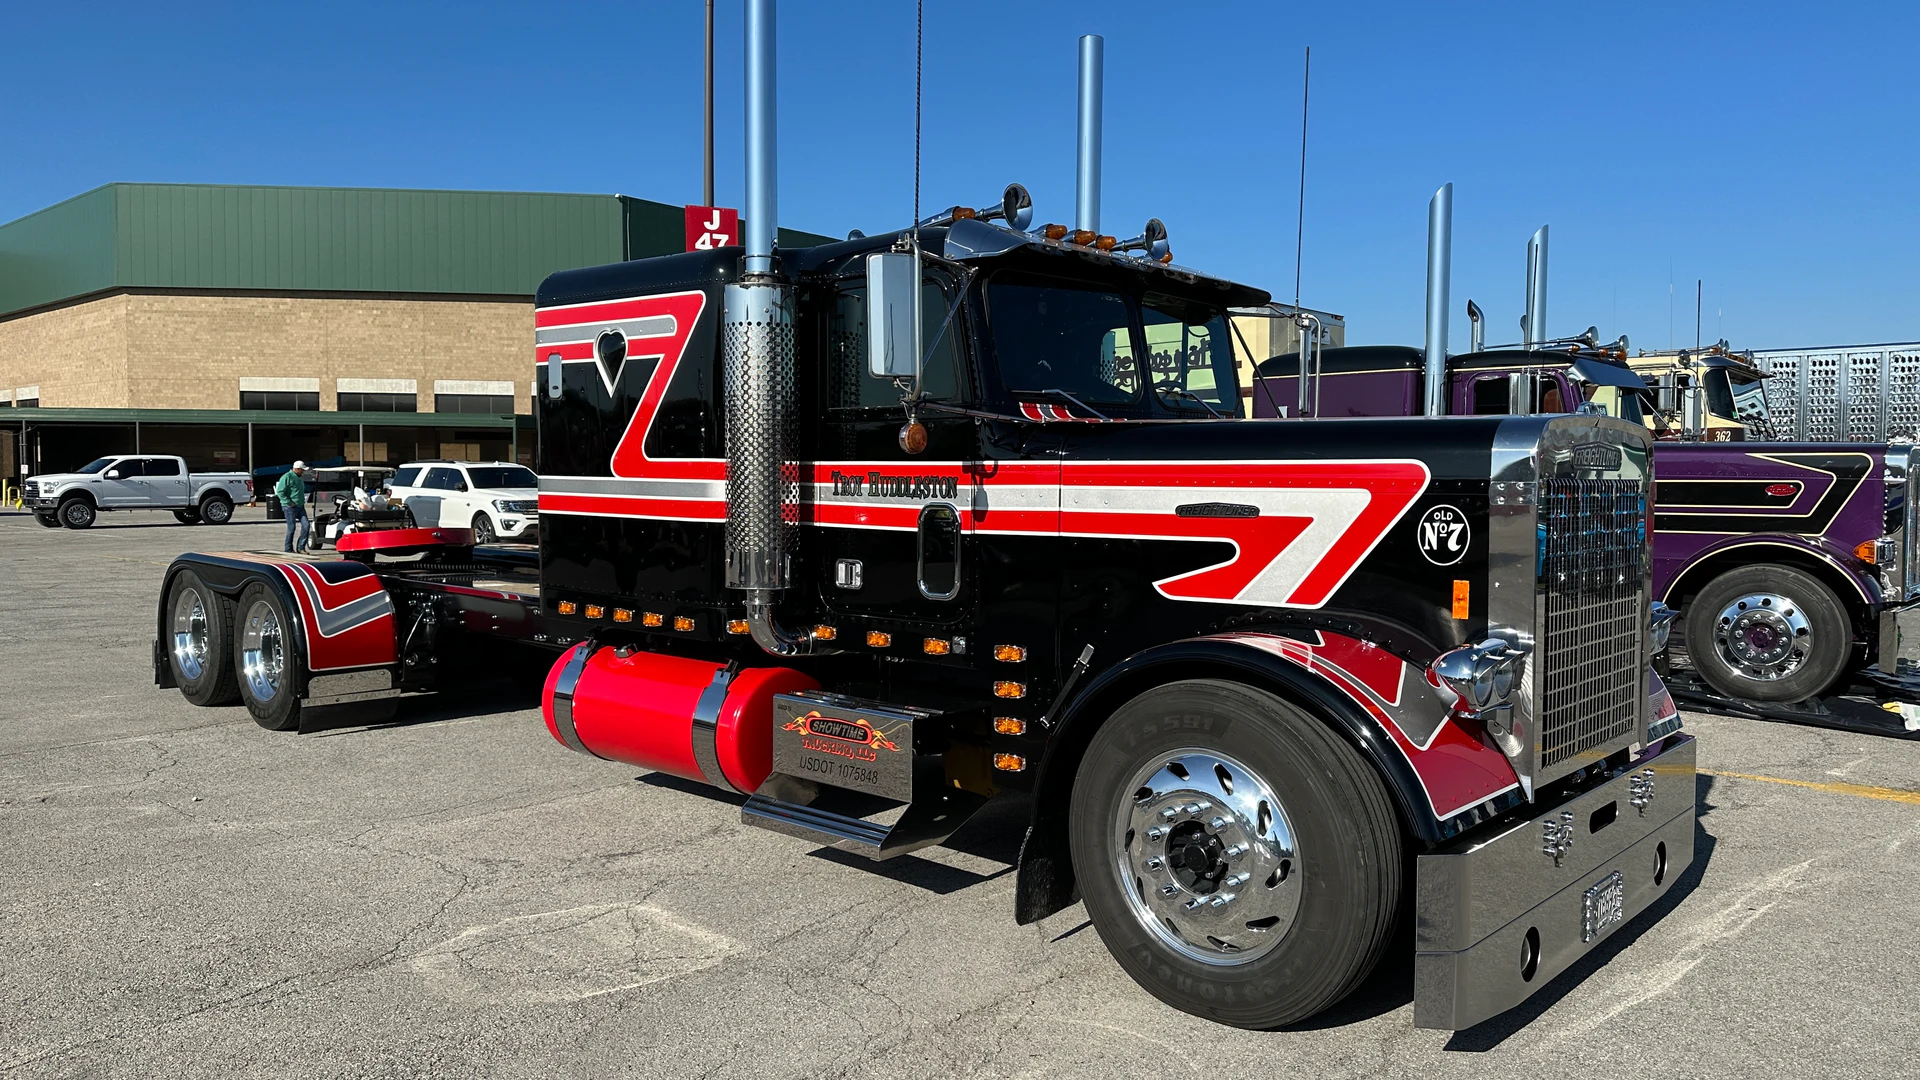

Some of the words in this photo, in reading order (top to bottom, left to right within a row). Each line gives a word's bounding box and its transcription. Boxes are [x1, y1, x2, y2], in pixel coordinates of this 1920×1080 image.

[703, 209, 720, 231] J
[695, 232, 729, 250] 47
[1714, 430, 1731, 442] 362
[1179, 503, 1257, 516] FREIGHTLINER
[1433, 509, 1453, 520] OLD
[812, 720, 865, 740] SHOWTIME
[800, 755, 835, 775] USDOT
[838, 763, 879, 785] 1075848
